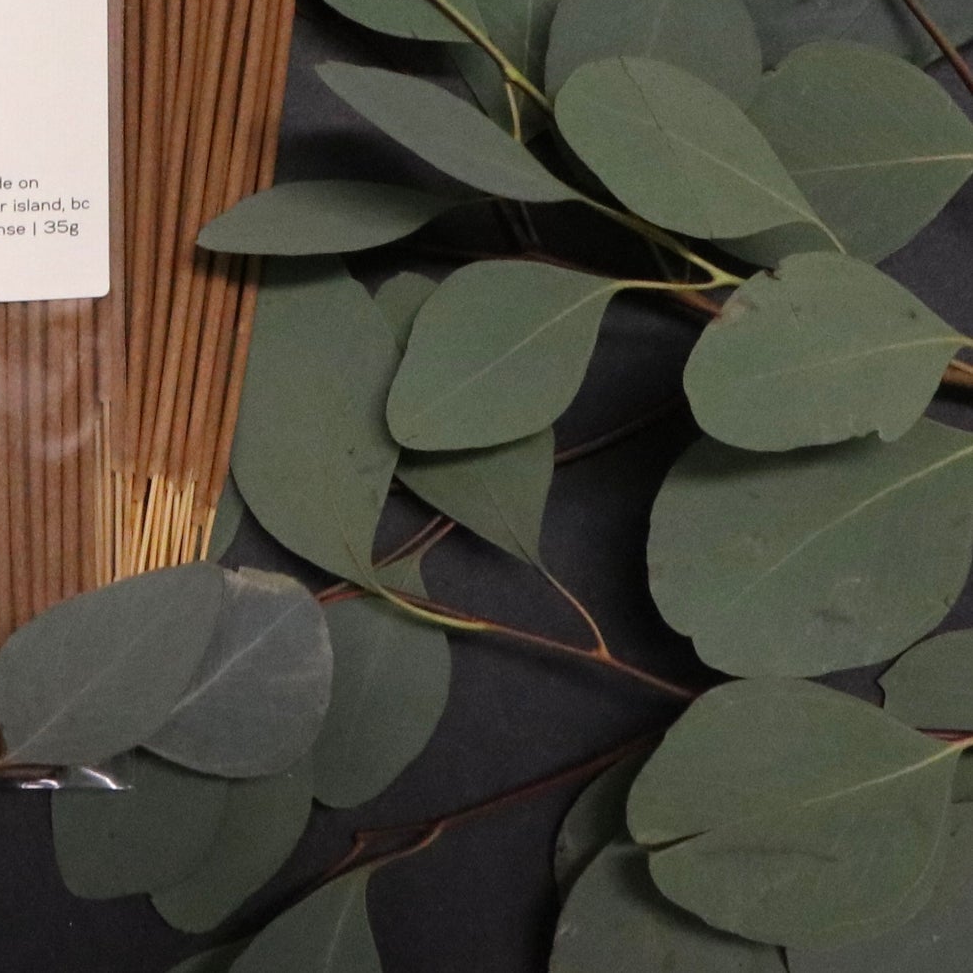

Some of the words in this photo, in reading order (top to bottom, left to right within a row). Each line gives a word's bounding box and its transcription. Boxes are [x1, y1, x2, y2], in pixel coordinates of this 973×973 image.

[19, 179, 38, 189] on
[14, 198, 65, 212] island,
[71, 197, 89, 210] bc
[44, 220, 79, 236] 35g
